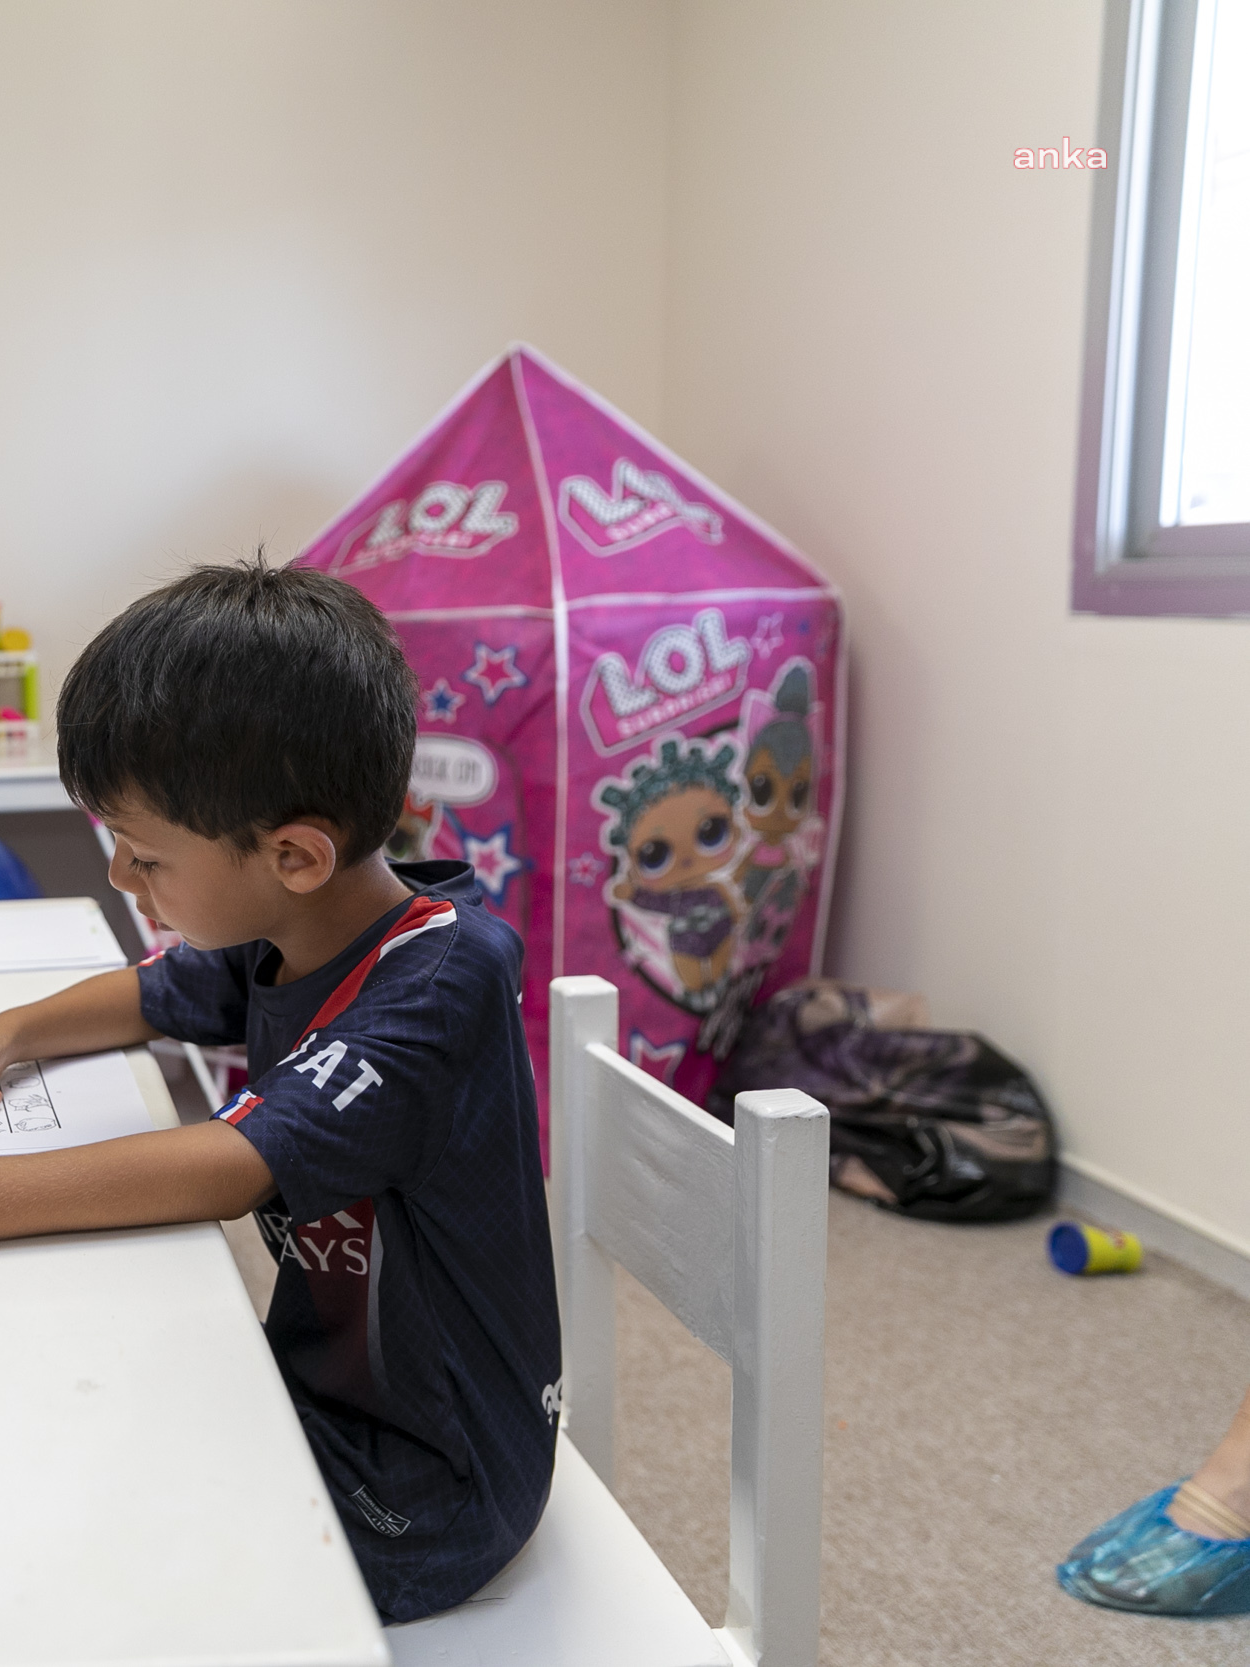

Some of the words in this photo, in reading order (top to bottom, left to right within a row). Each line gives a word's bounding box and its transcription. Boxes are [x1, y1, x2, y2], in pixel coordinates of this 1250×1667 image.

[363, 480, 520, 548] LOL
[596, 608, 749, 717] LOL
[275, 1032, 384, 1112] AT
